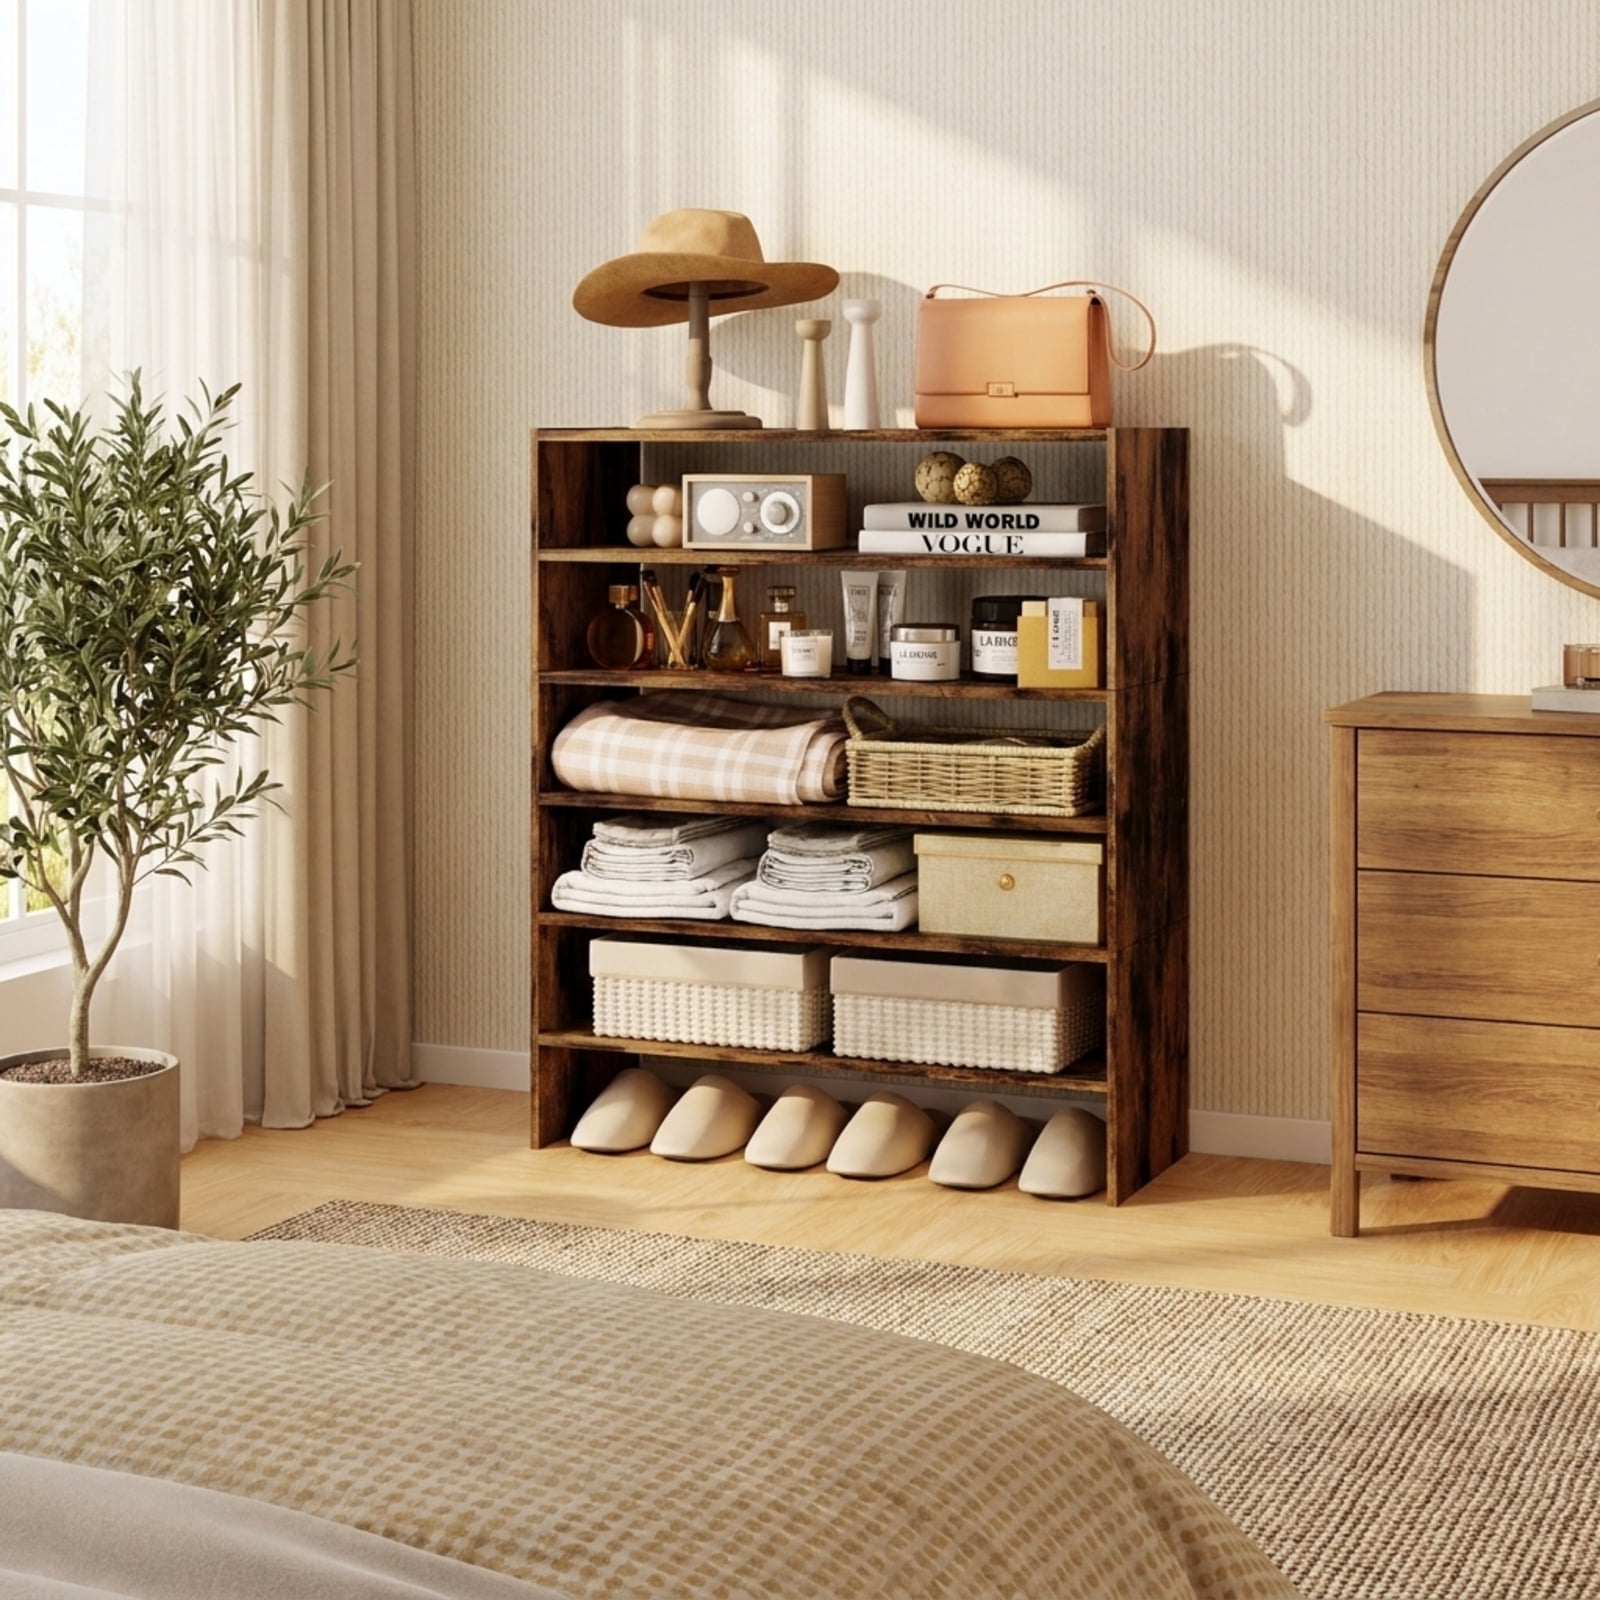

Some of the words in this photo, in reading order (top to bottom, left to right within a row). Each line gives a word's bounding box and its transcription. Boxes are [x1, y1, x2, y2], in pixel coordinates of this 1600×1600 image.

[908, 513, 958, 529] WILD
[966, 513, 1040, 529] WORLD
[922, 535, 1024, 554] VOGUE
